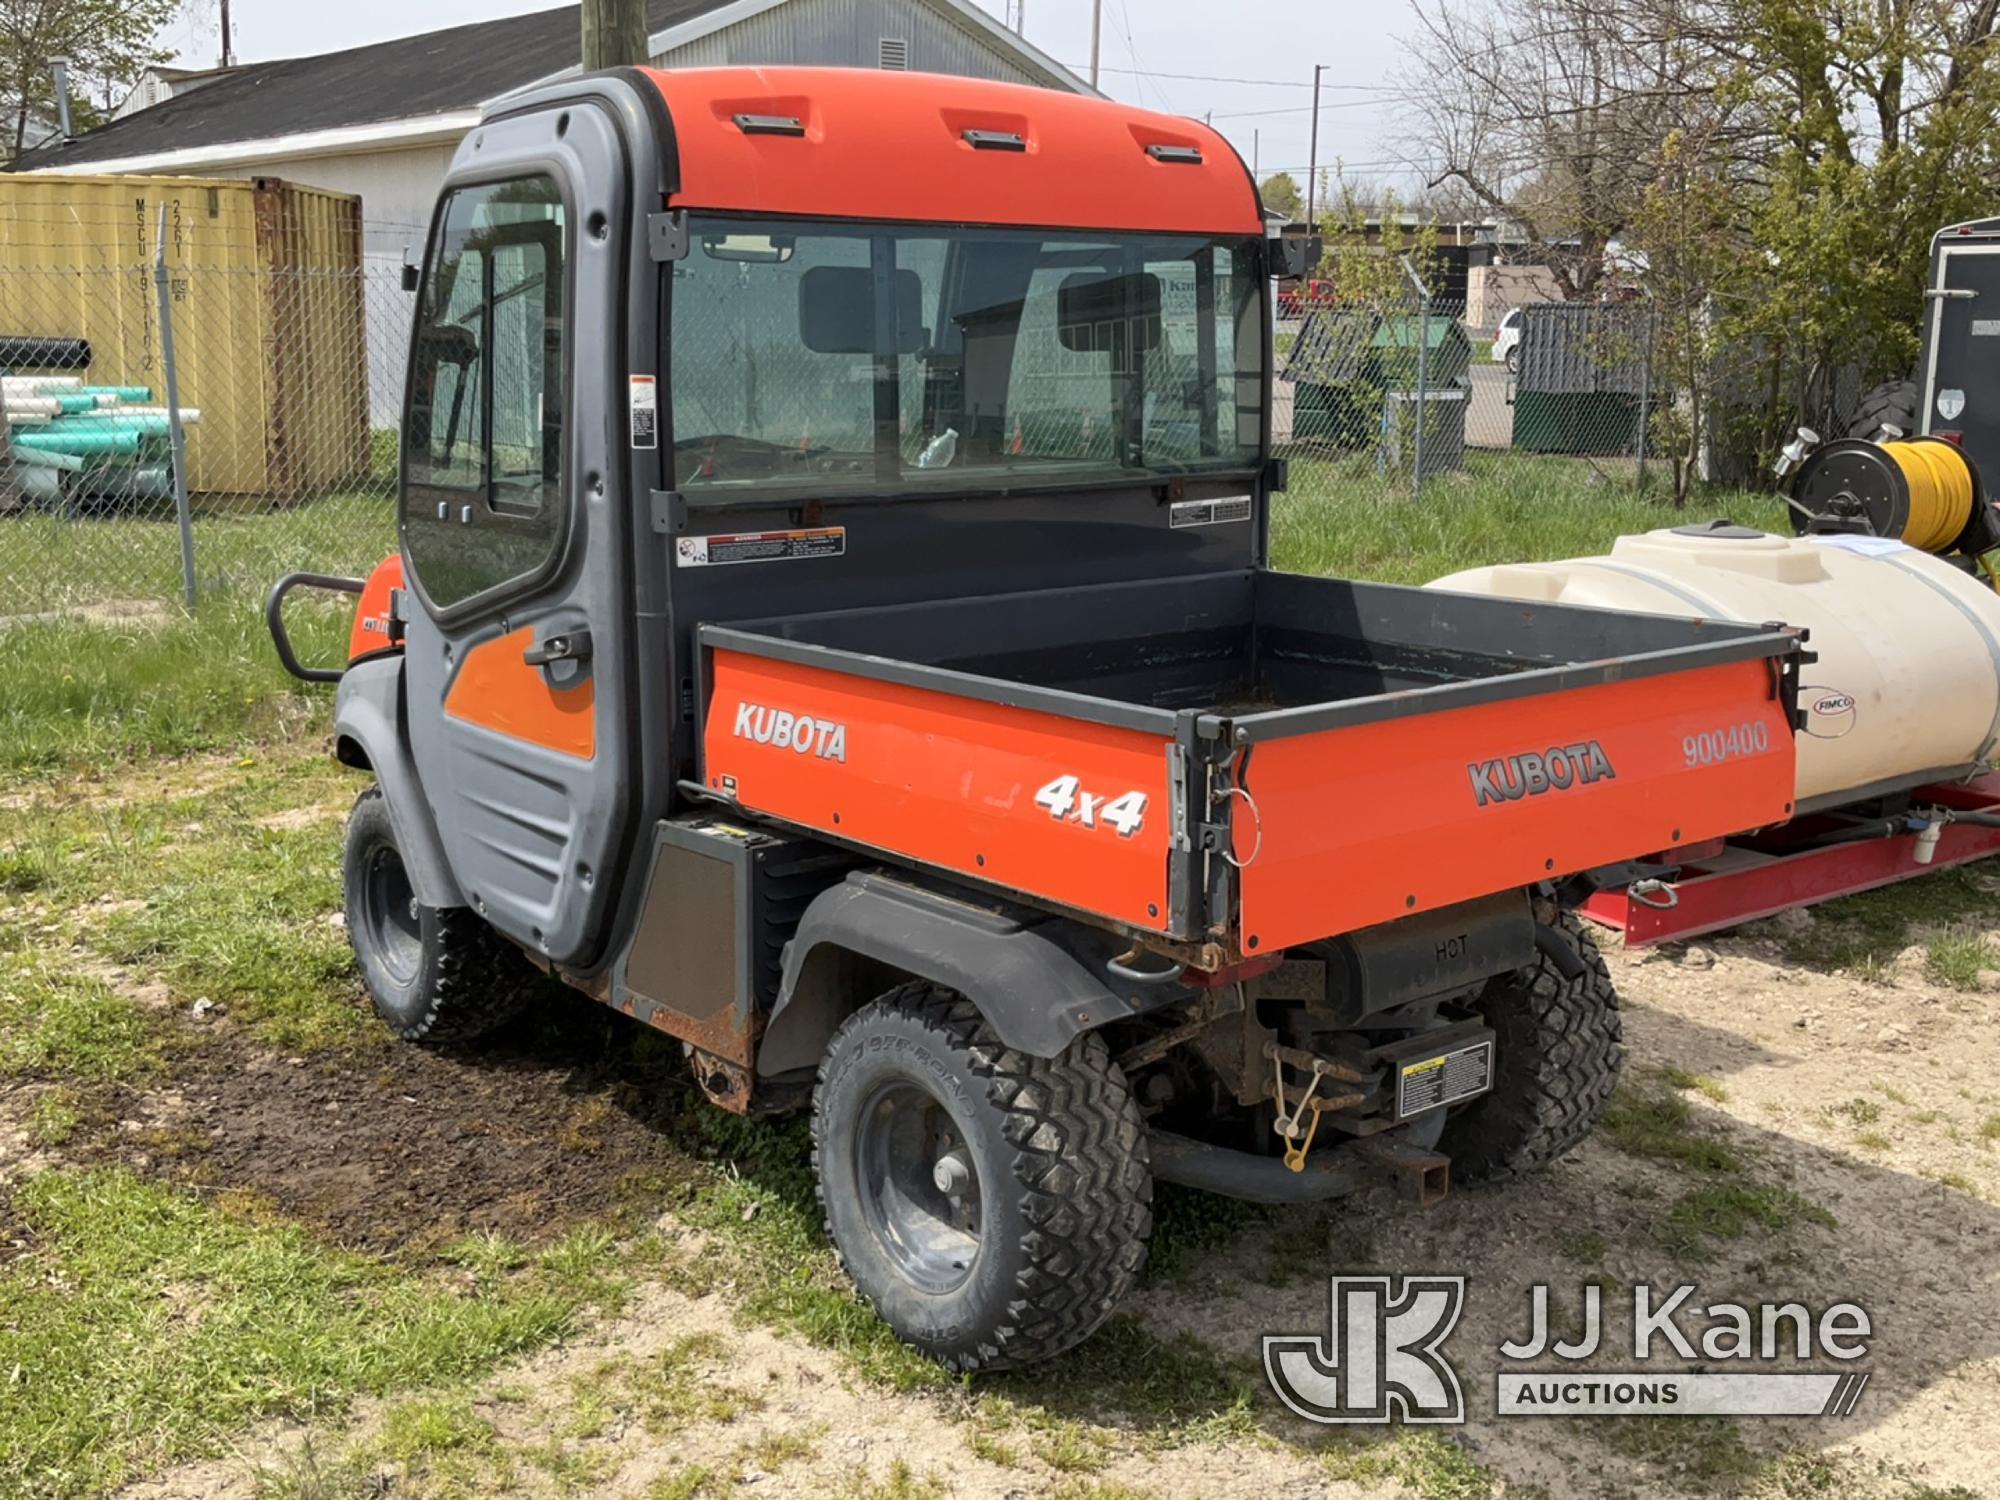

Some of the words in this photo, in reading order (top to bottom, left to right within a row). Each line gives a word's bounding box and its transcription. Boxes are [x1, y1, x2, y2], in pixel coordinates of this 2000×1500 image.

[1819, 697, 1851, 710] FIMCO
[733, 701, 846, 764] KUBOTA
[1682, 720, 1769, 767] 900400
[1467, 740, 1616, 806] KUBOTA
[1034, 774, 1148, 838] 4x4
[1435, 934, 1468, 962] HOT
